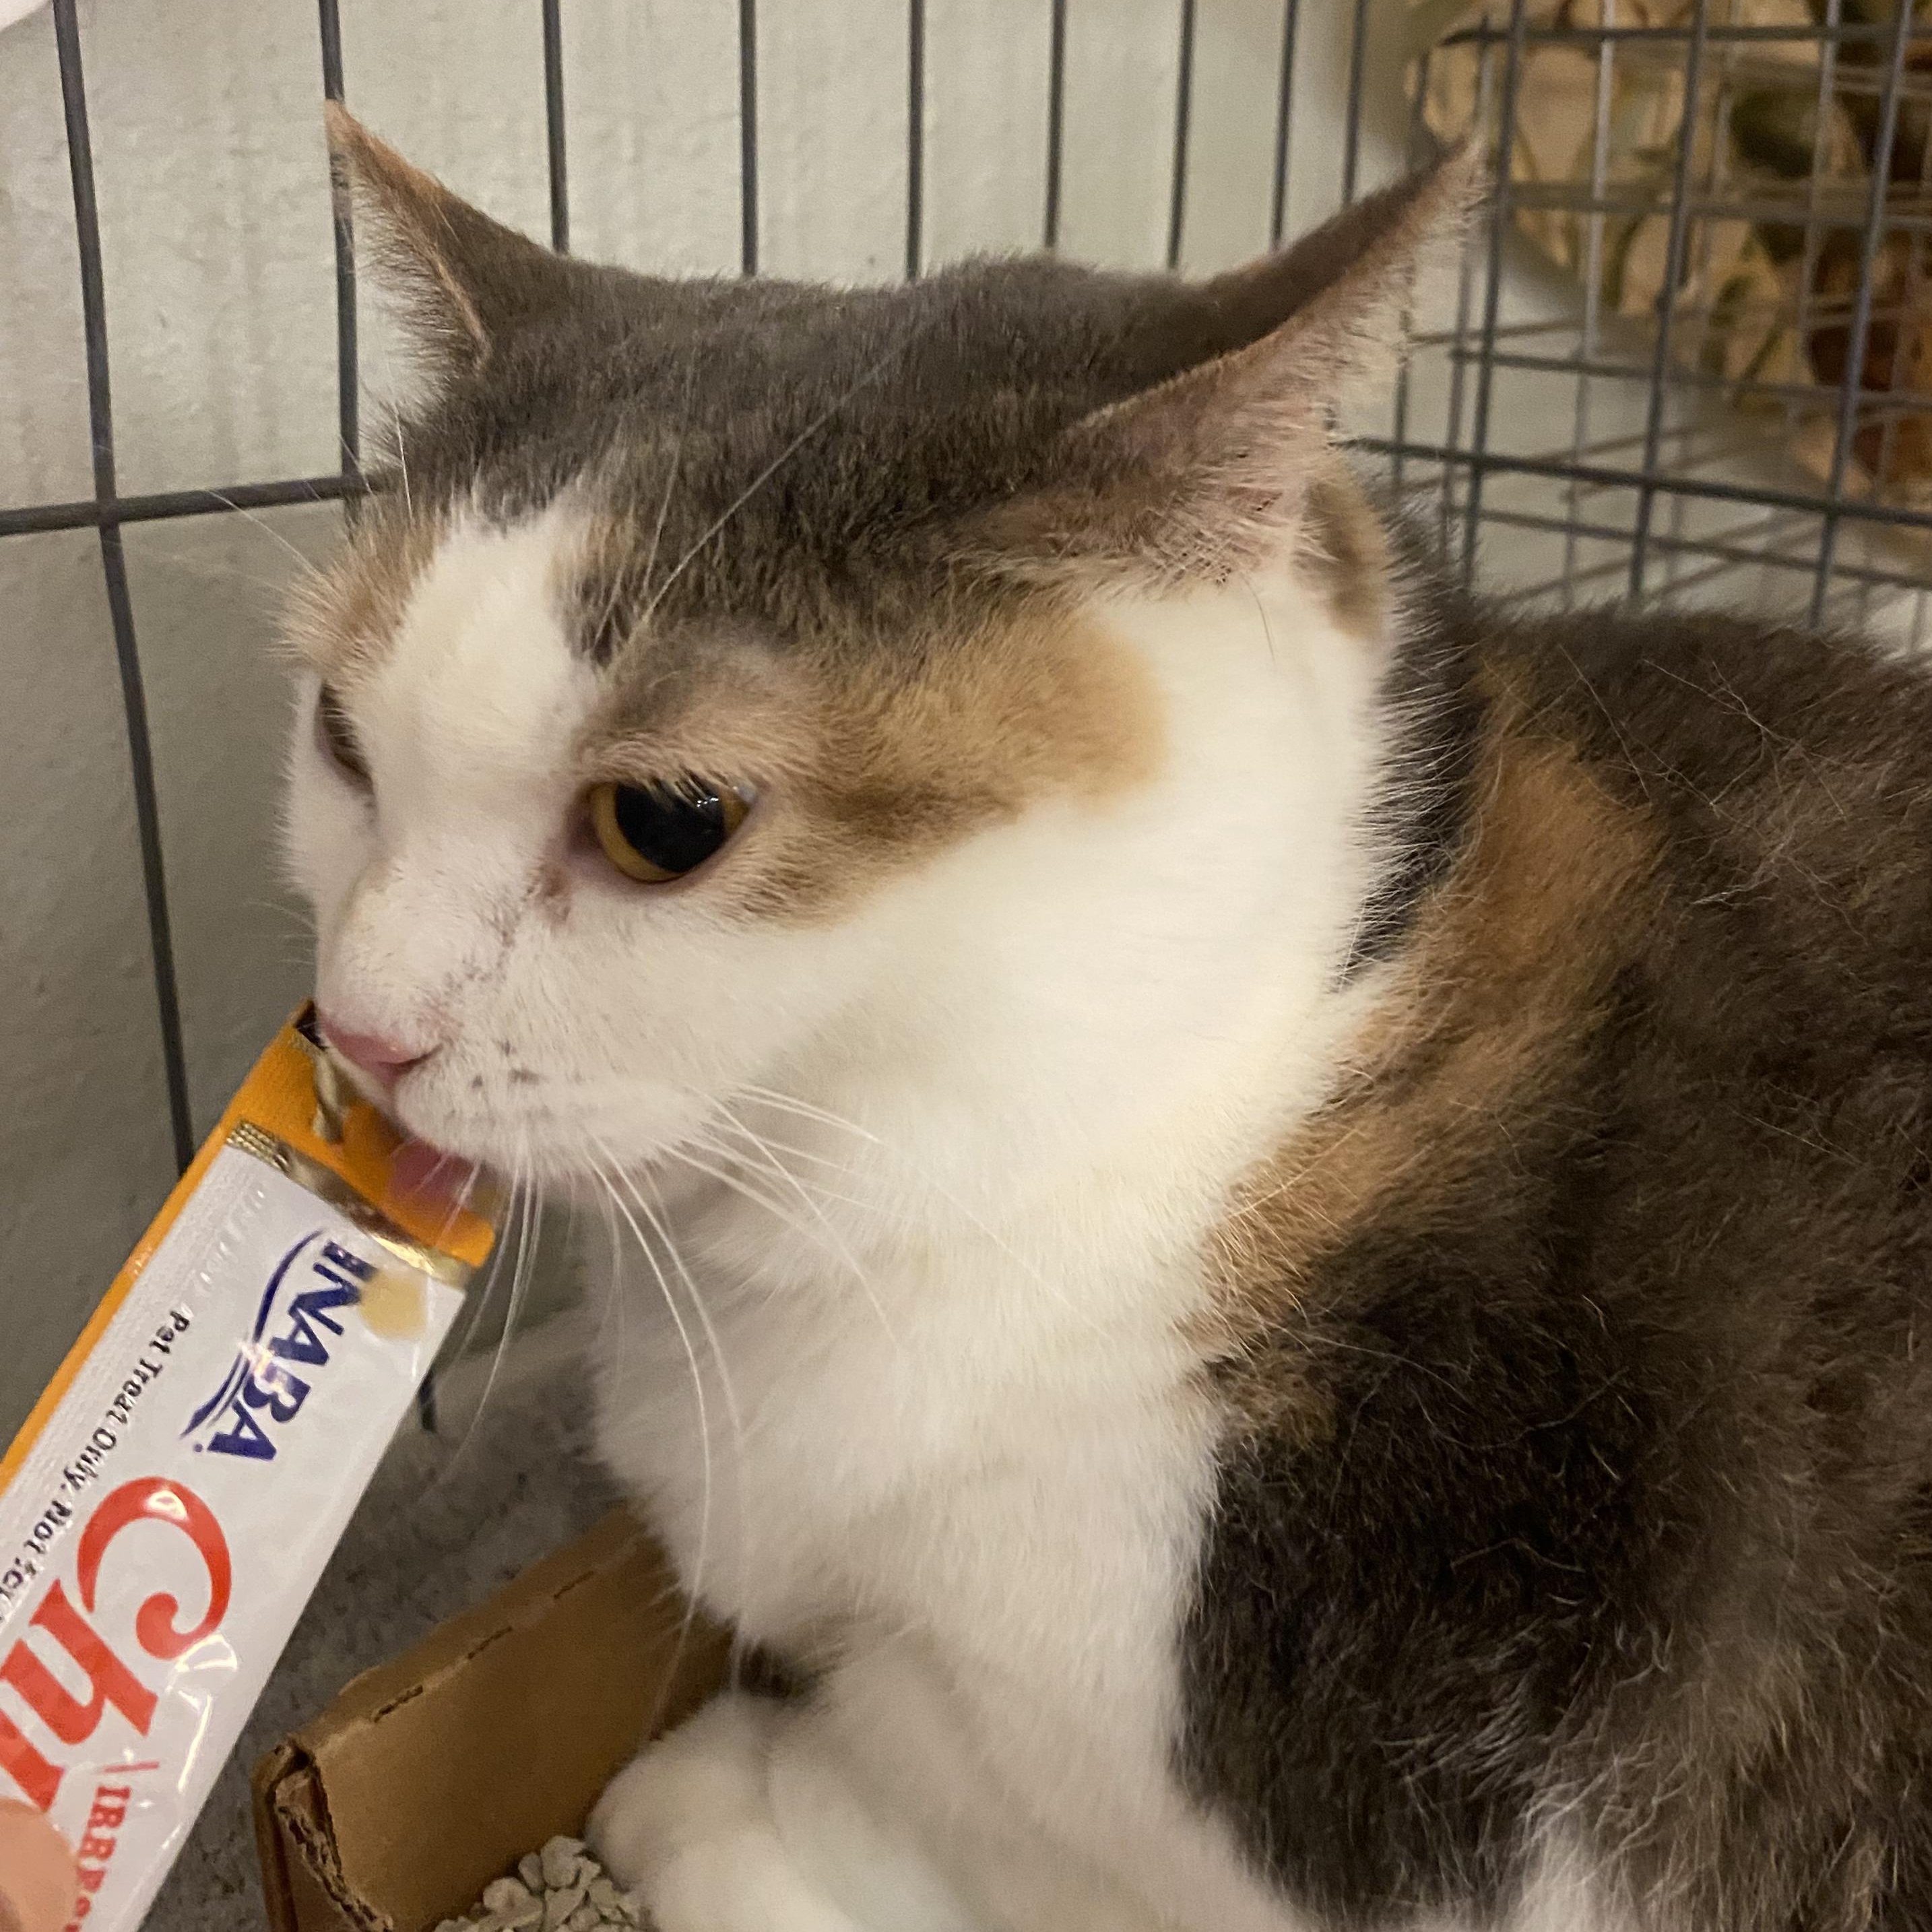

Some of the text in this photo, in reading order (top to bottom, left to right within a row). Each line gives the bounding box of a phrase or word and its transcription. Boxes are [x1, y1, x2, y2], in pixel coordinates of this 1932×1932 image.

[148, 1310, 190, 1355] Pet
[207, 1240, 379, 1460] INABA
[105, 1357, 164, 1425] Treat
[23, 1500, 73, 1555] Not
